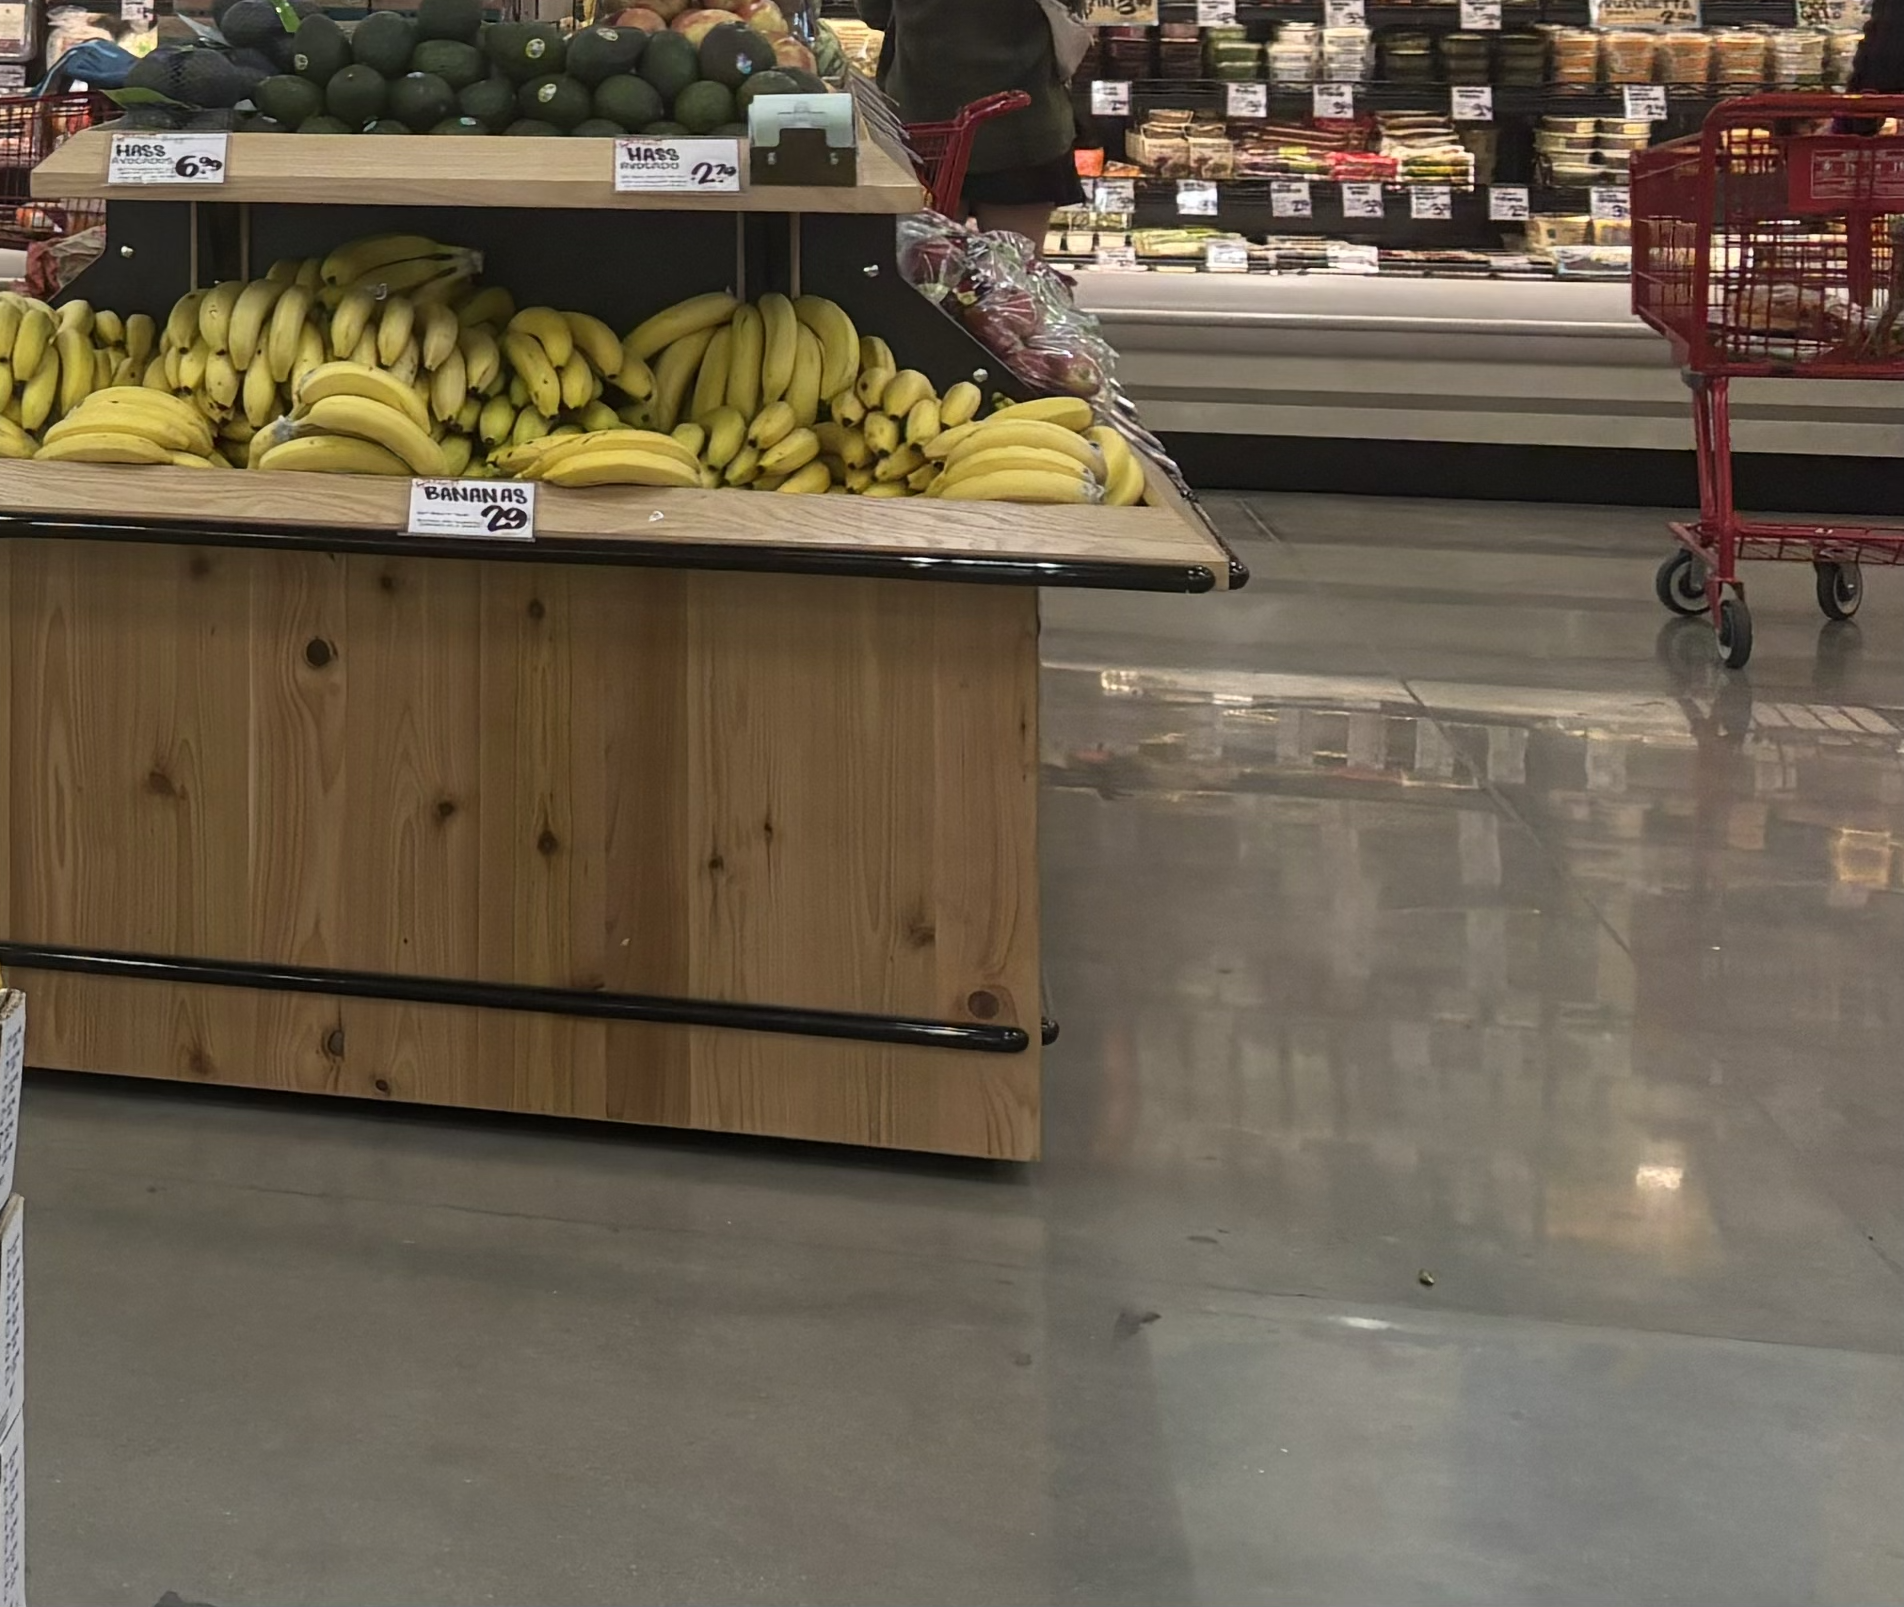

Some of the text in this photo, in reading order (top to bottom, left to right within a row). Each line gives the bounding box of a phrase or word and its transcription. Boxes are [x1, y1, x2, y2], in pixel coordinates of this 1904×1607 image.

[116, 144, 166, 157] HASS
[627, 146, 680, 161] HASS
[175, 155, 223, 178] 6.99
[424, 486, 528, 505] BANANAS
[481, 505, 528, 532] 29
